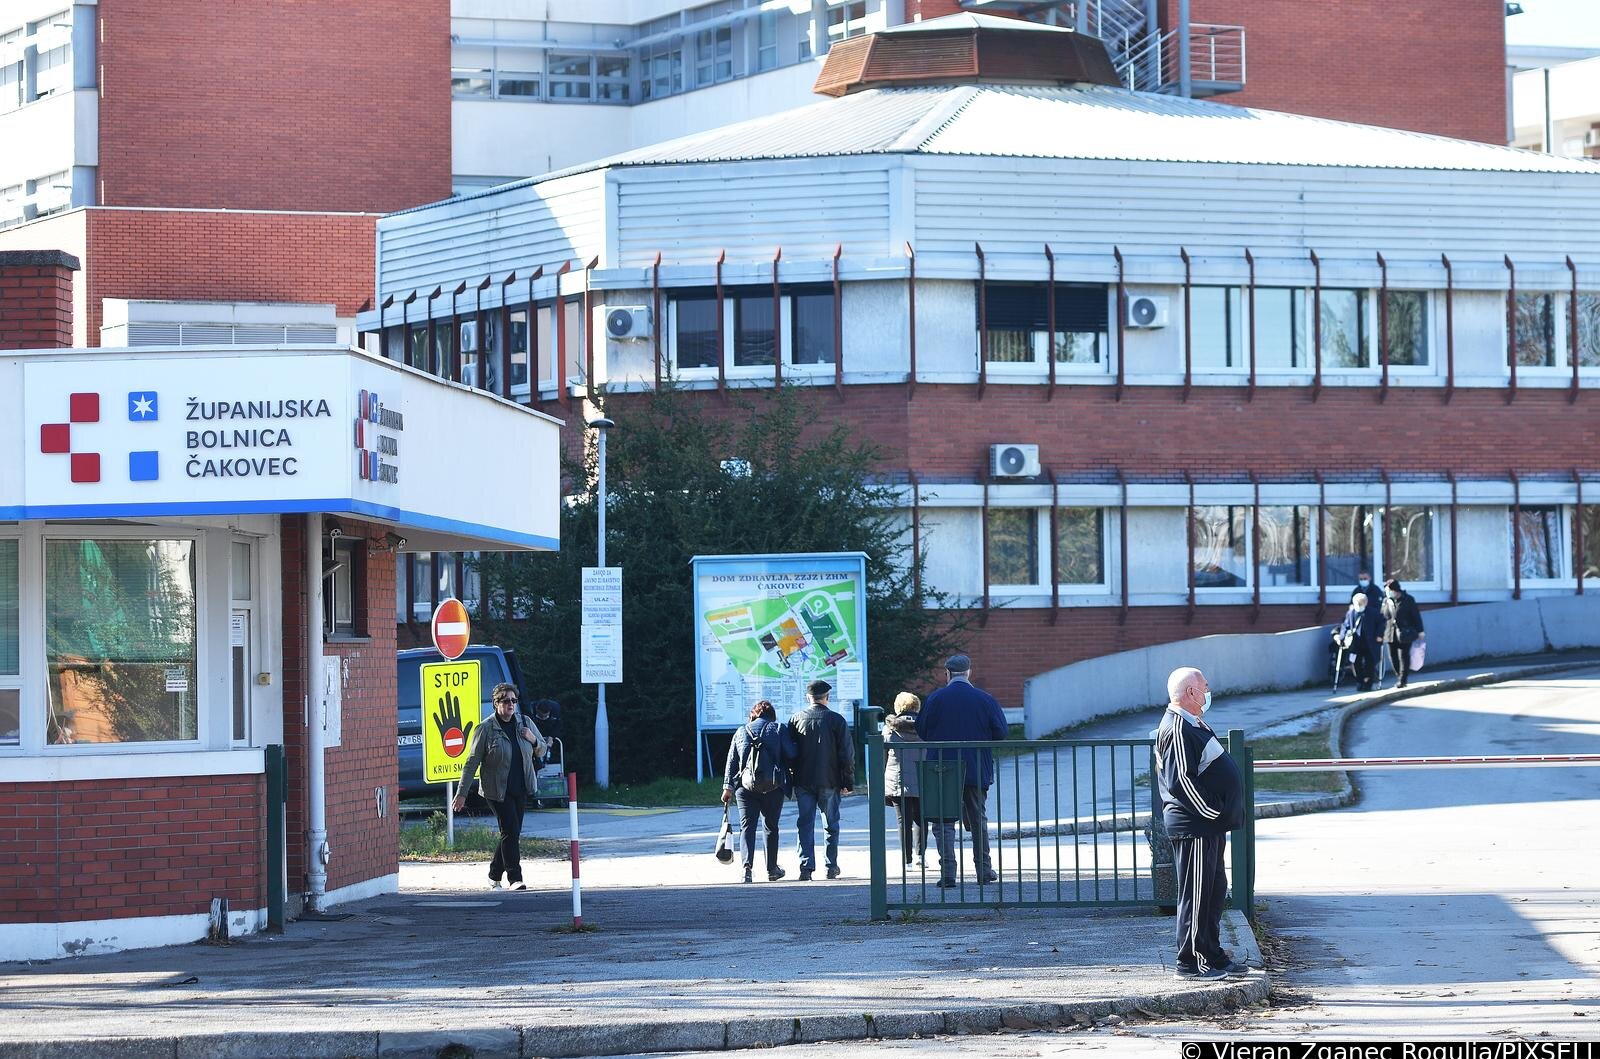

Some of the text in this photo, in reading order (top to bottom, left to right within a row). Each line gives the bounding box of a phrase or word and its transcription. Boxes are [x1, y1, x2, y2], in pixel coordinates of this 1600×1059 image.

[186, 396, 332, 420] ŽUPANIJSKA
[186, 428, 293, 449] BOLNICA
[186, 454, 299, 478] ČAKOVEC
[434, 671, 469, 689] STOP
[433, 764, 452, 775] KRIVI
